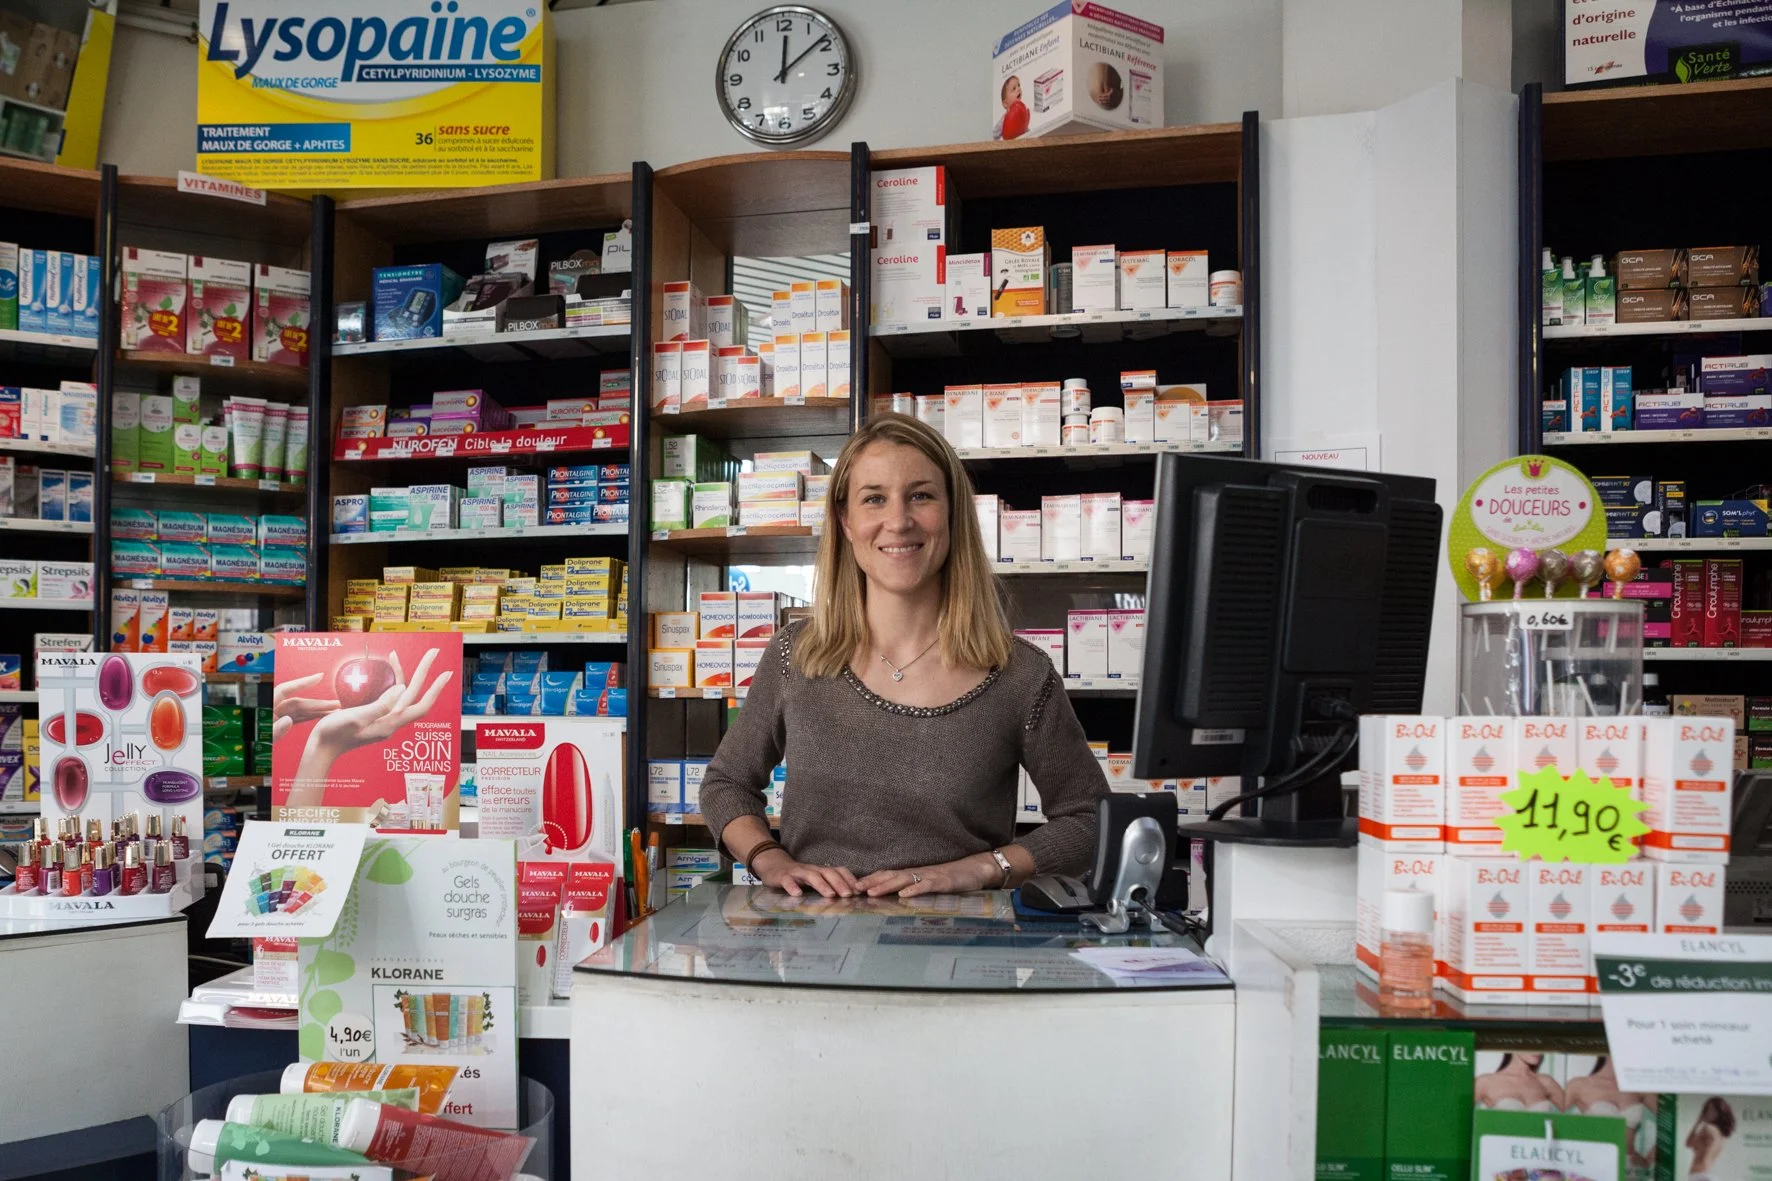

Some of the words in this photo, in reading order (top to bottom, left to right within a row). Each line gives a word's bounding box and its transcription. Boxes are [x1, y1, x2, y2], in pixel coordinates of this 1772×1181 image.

[1685, 3, 1705, 12] base
[1573, 9, 1636, 26] d'origine
[1680, 10, 1733, 22] l'organisme
[1712, 21, 1722, 29] et
[1724, 19, 1737, 27] les
[755, 30, 763, 42] 11
[777, 19, 793, 32] 12
[807, 22, 811, 35] 1
[1573, 30, 1636, 47] naturelle
[737, 49, 750, 63] 10
[820, 39, 831, 52] 2
[1001, 47, 1038, 74] LACTIBIANE
[1039, 36, 1060, 53] Enfant
[1079, 37, 1125, 61] LACTIBIANE
[1127, 52, 1157, 71] Référence
[1689, 48, 1730, 64] Santé
[362, 68, 466, 79] CETYLPYRIDINIUM
[474, 68, 537, 79] LYSOZYME
[1694, 61, 1732, 75] Verte
[729, 74, 742, 86] 9
[827, 63, 840, 76] 3
[252, 77, 283, 88] MAUX
[285, 77, 298, 88] DE
[300, 77, 338, 88] GORGE
[738, 97, 751, 110] 8
[820, 88, 832, 100] 4
[756, 114, 765, 127] 7
[778, 117, 791, 129] 6
[803, 108, 816, 120] 5
[202, 127, 271, 138] TRAITEMENT
[415, 133, 433, 145] 36
[439, 125, 470, 136] sans
[473, 125, 510, 136] sucre
[202, 141, 235, 151] MAUX
[237, 140, 251, 151] DE
[254, 140, 292, 151] GORGE
[303, 140, 345, 150] APHTES
[438, 137, 475, 145] comprimés
[877, 177, 918, 188] Ceroline
[184, 178, 262, 200] VITAMINES
[551, 259, 582, 270] PILBOX
[877, 255, 919, 266] Ceroline
[1622, 256, 1643, 264] GCA
[792, 311, 814, 319] Drosétux
[1704, 362, 1749, 370] ACTIRUB
[551, 408, 581, 416] NUROFEN
[392, 437, 457, 453] NUROFEN
[465, 437, 496, 449] Cible
[499, 436, 512, 447] la
[515, 433, 567, 448] douleur
[665, 441, 678, 450] L52
[1302, 453, 1339, 461] NOUVEAU
[469, 468, 504, 476] ASPIRINE
[551, 468, 594, 479] PRONTALGINE
[410, 486, 448, 495] ASPIRINE
[551, 490, 594, 500] PRONTALGINE
[1504, 485, 1522, 495] Les
[1525, 485, 1560, 496] petites
[334, 498, 364, 506] ASPRO
[1489, 498, 1571, 516] DOUCEURS
[695, 504, 728, 513] Rhinallergy
[547, 511, 591, 521] PRONTALGINE
[162, 521, 204, 532] MAGNÉSIUM
[567, 558, 602, 567] Doliprane
[42, 567, 90, 577] Strepsils
[113, 594, 138, 604] Alvityl
[662, 625, 691, 636] Sinuspax
[40, 638, 82, 647] Strefen
[283, 637, 343, 647] MAVALA
[41, 658, 97, 666] MAVALA
[414, 729, 452, 741] suisse
[484, 729, 537, 737] MAVALA
[1395, 723, 1437, 739] Bi-Oil
[1461, 723, 1504, 740] Bi-Oil
[1524, 723, 1568, 739] Bi-Oil
[1585, 724, 1629, 740] Bi-Oil
[1680, 725, 1726, 742] Bi-Oil
[384, 748, 398, 760] DE
[401, 741, 451, 760] SOIN
[387, 761, 410, 772] DES
[413, 760, 451, 772] MAINS
[481, 767, 541, 776] CORRECTEUR
[650, 766, 663, 776] L72
[687, 767, 699, 776] L72
[481, 786, 512, 795] efface
[513, 787, 536, 795] toutes
[493, 796, 530, 805] erreurs
[279, 808, 340, 818] SPECIFIC
[1516, 790, 1621, 841] 11,90
[1608, 834, 1622, 852] €
[271, 849, 326, 861] OFFERT
[677, 856, 709, 864] Arnigel
[454, 876, 479, 889] Gels
[444, 889, 490, 904] douche
[447, 907, 487, 921] surgras
[429, 931, 445, 939] Peaux
[480, 932, 507, 940] sensibles
[559, 920, 568, 961] CORRECTEUR
[1681, 940, 1745, 954] ELANCYL
[371, 967, 444, 981] KLORANE
[1650, 975, 1674, 989] de
[1677, 972, 1752, 990] réduction
[1627, 1018, 1656, 1031] Pour
[330, 1026, 372, 1044] 4,90€
[340, 1047, 360, 1058] l'un
[1318, 1044, 1381, 1062] LANCYL
[1393, 1045, 1469, 1062] ELANCYL
